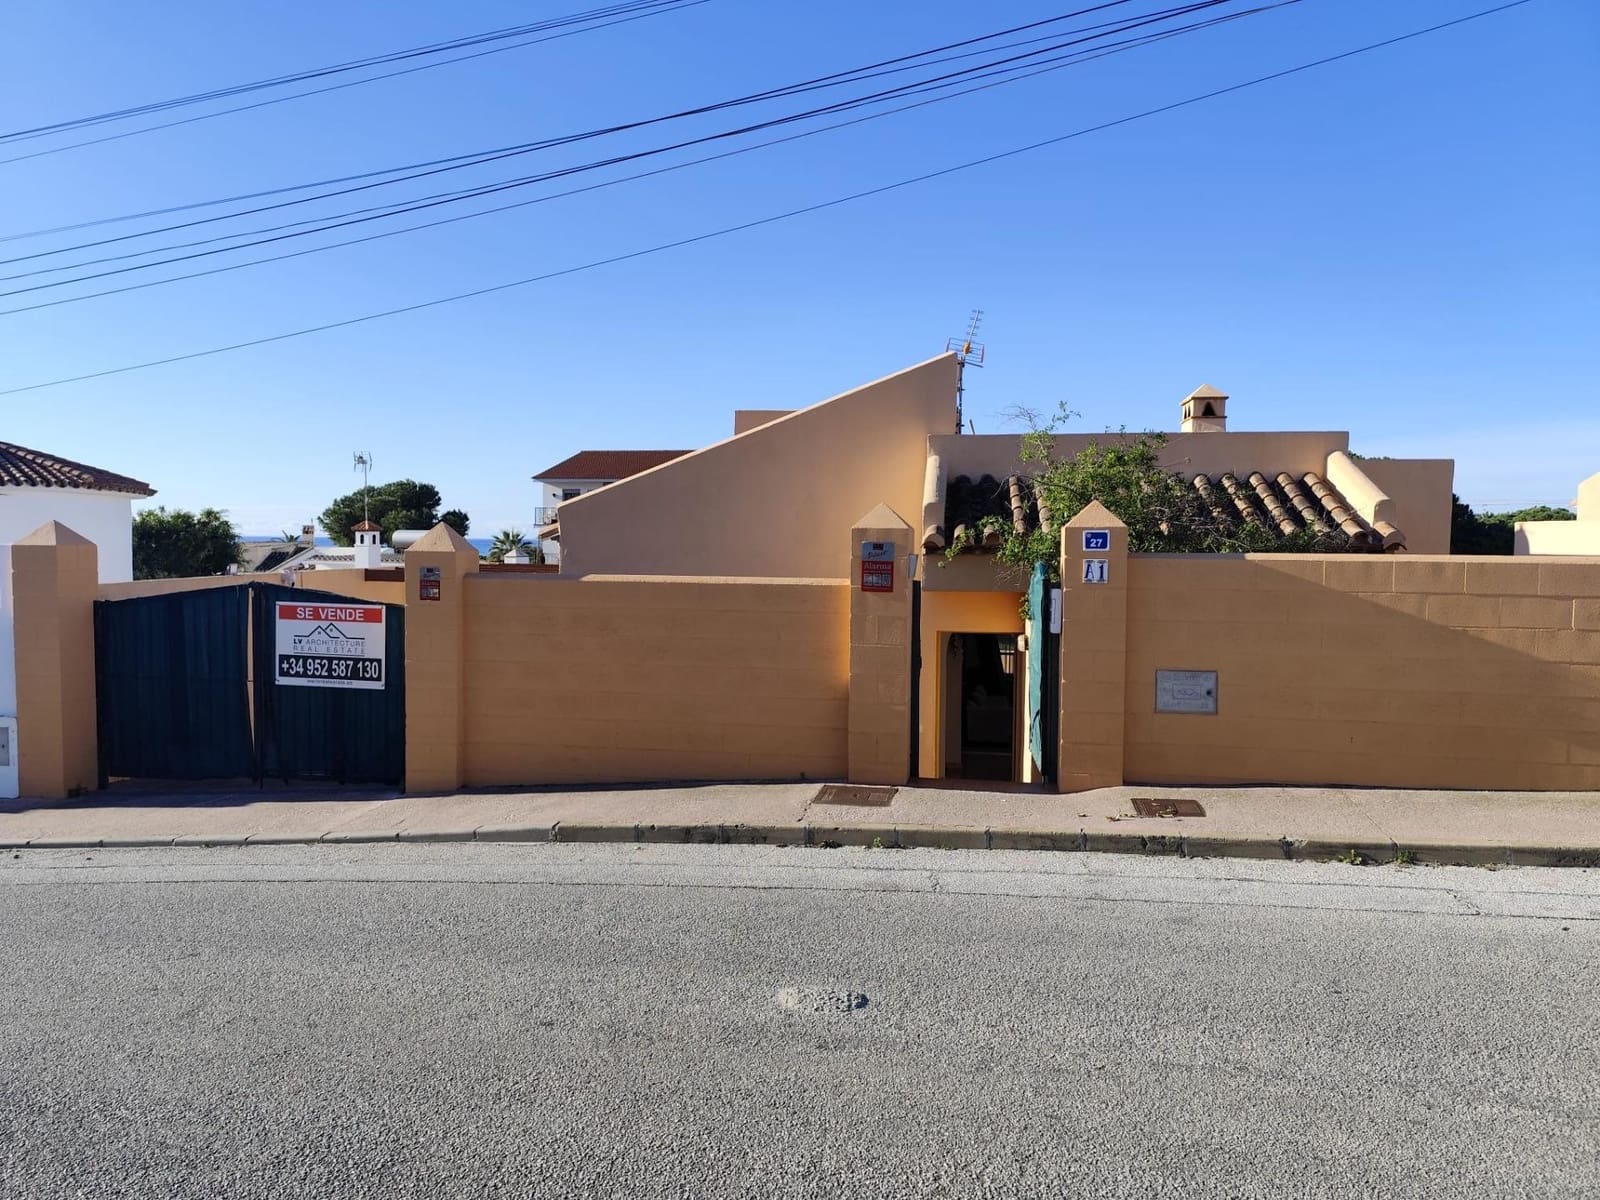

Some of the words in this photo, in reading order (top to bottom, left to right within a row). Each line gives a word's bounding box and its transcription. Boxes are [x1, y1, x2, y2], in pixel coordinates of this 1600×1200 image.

[1090, 538, 1102, 547] 27
[297, 607, 313, 619] SE
[319, 608, 365, 621] VENDE
[305, 639, 365, 647] ARCHITECTURE
[326, 646, 365, 654] ESTATE
[282, 658, 304, 675] +34
[307, 659, 328, 676] 952
[332, 660, 353, 677] 587
[357, 661, 379, 678] 130
